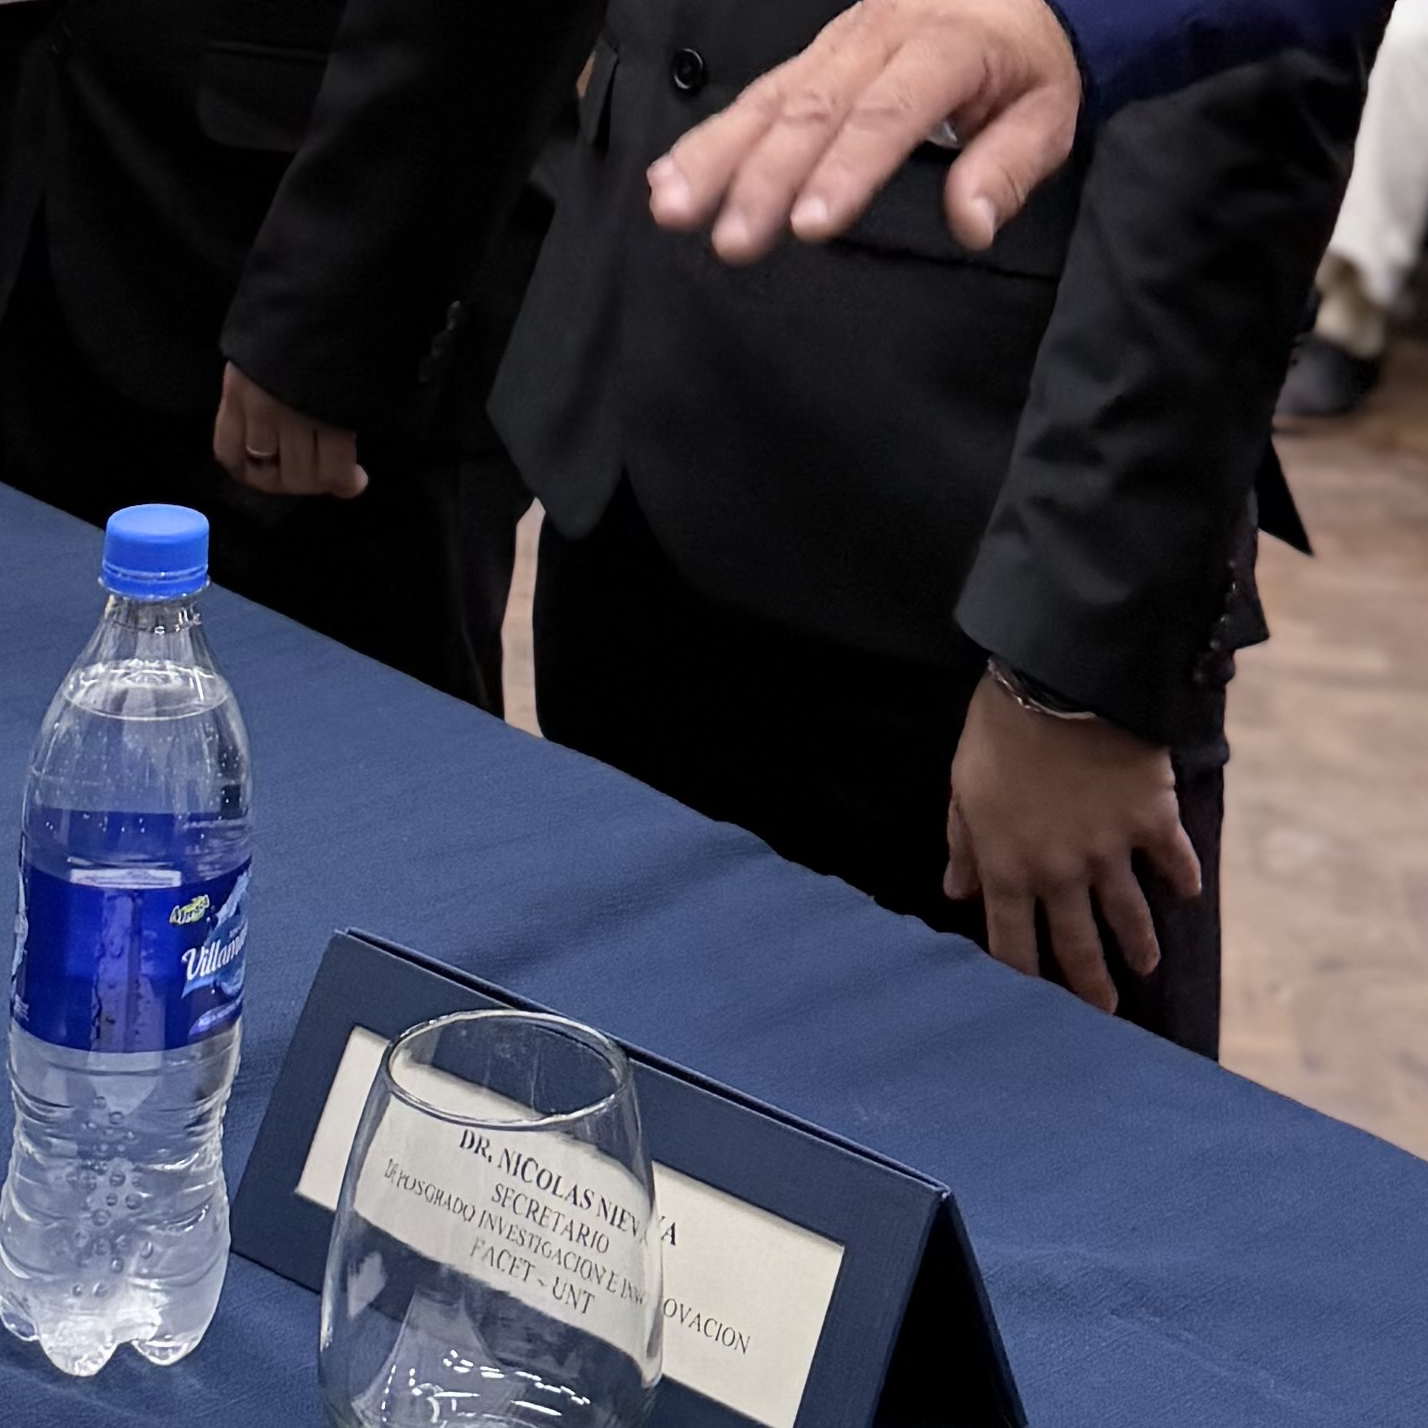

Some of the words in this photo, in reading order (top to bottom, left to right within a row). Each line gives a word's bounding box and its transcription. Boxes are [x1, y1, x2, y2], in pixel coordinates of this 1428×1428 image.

[459, 1129, 493, 1163] DR.
[497, 1148, 595, 1210] NICOLAS
[478, 1209, 606, 1286] INVESTIGACION
[491, 1183, 610, 1254] SECRETARIO
[470, 1236, 536, 1283] FACET
[552, 1276, 595, 1314] UNT
